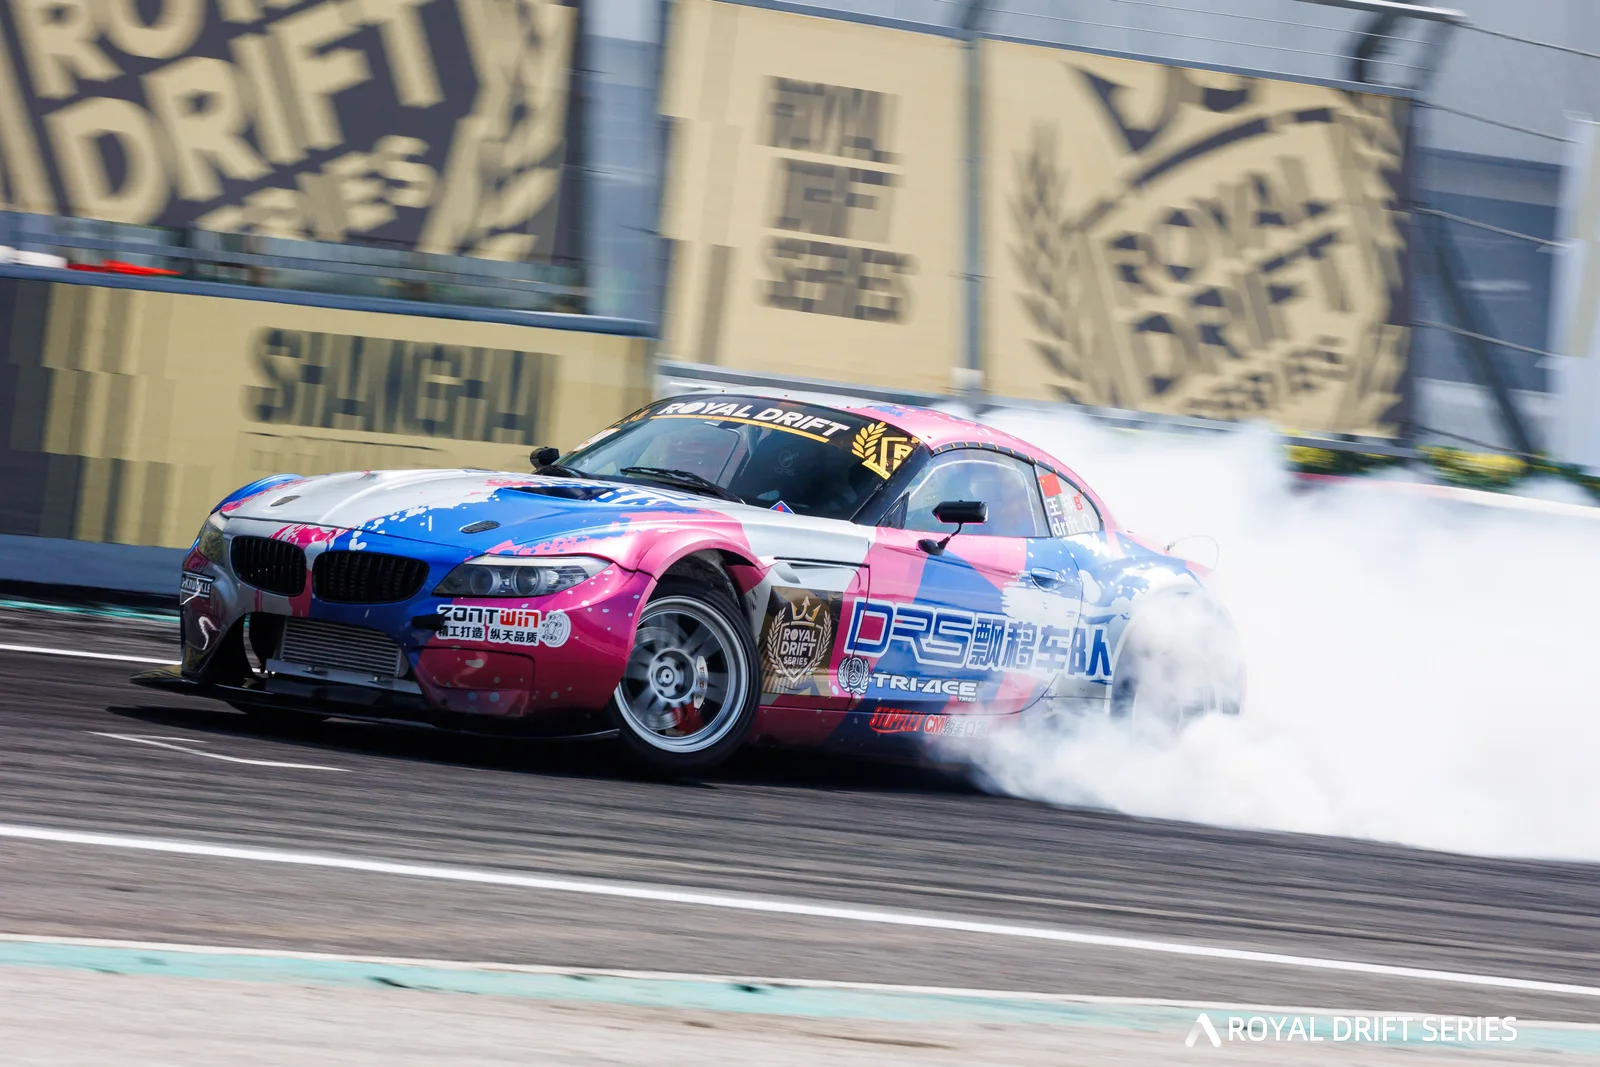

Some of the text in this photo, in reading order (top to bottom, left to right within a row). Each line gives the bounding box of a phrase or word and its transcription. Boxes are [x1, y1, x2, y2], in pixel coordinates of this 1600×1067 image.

[43, 0, 446, 226] DRIFT
[1103, 155, 1332, 310] ROYAL
[1128, 230, 1353, 398] DRIFT
[656, 402, 850, 437] ROYAL DRIFT
[490, 628, 538, 644] 纵天品质
[780, 641, 816, 657] DRIFT
[783, 628, 817, 642] ROYAL
[844, 597, 1114, 679] DRS 飘移车队
[783, 655, 809, 666] SERIES
